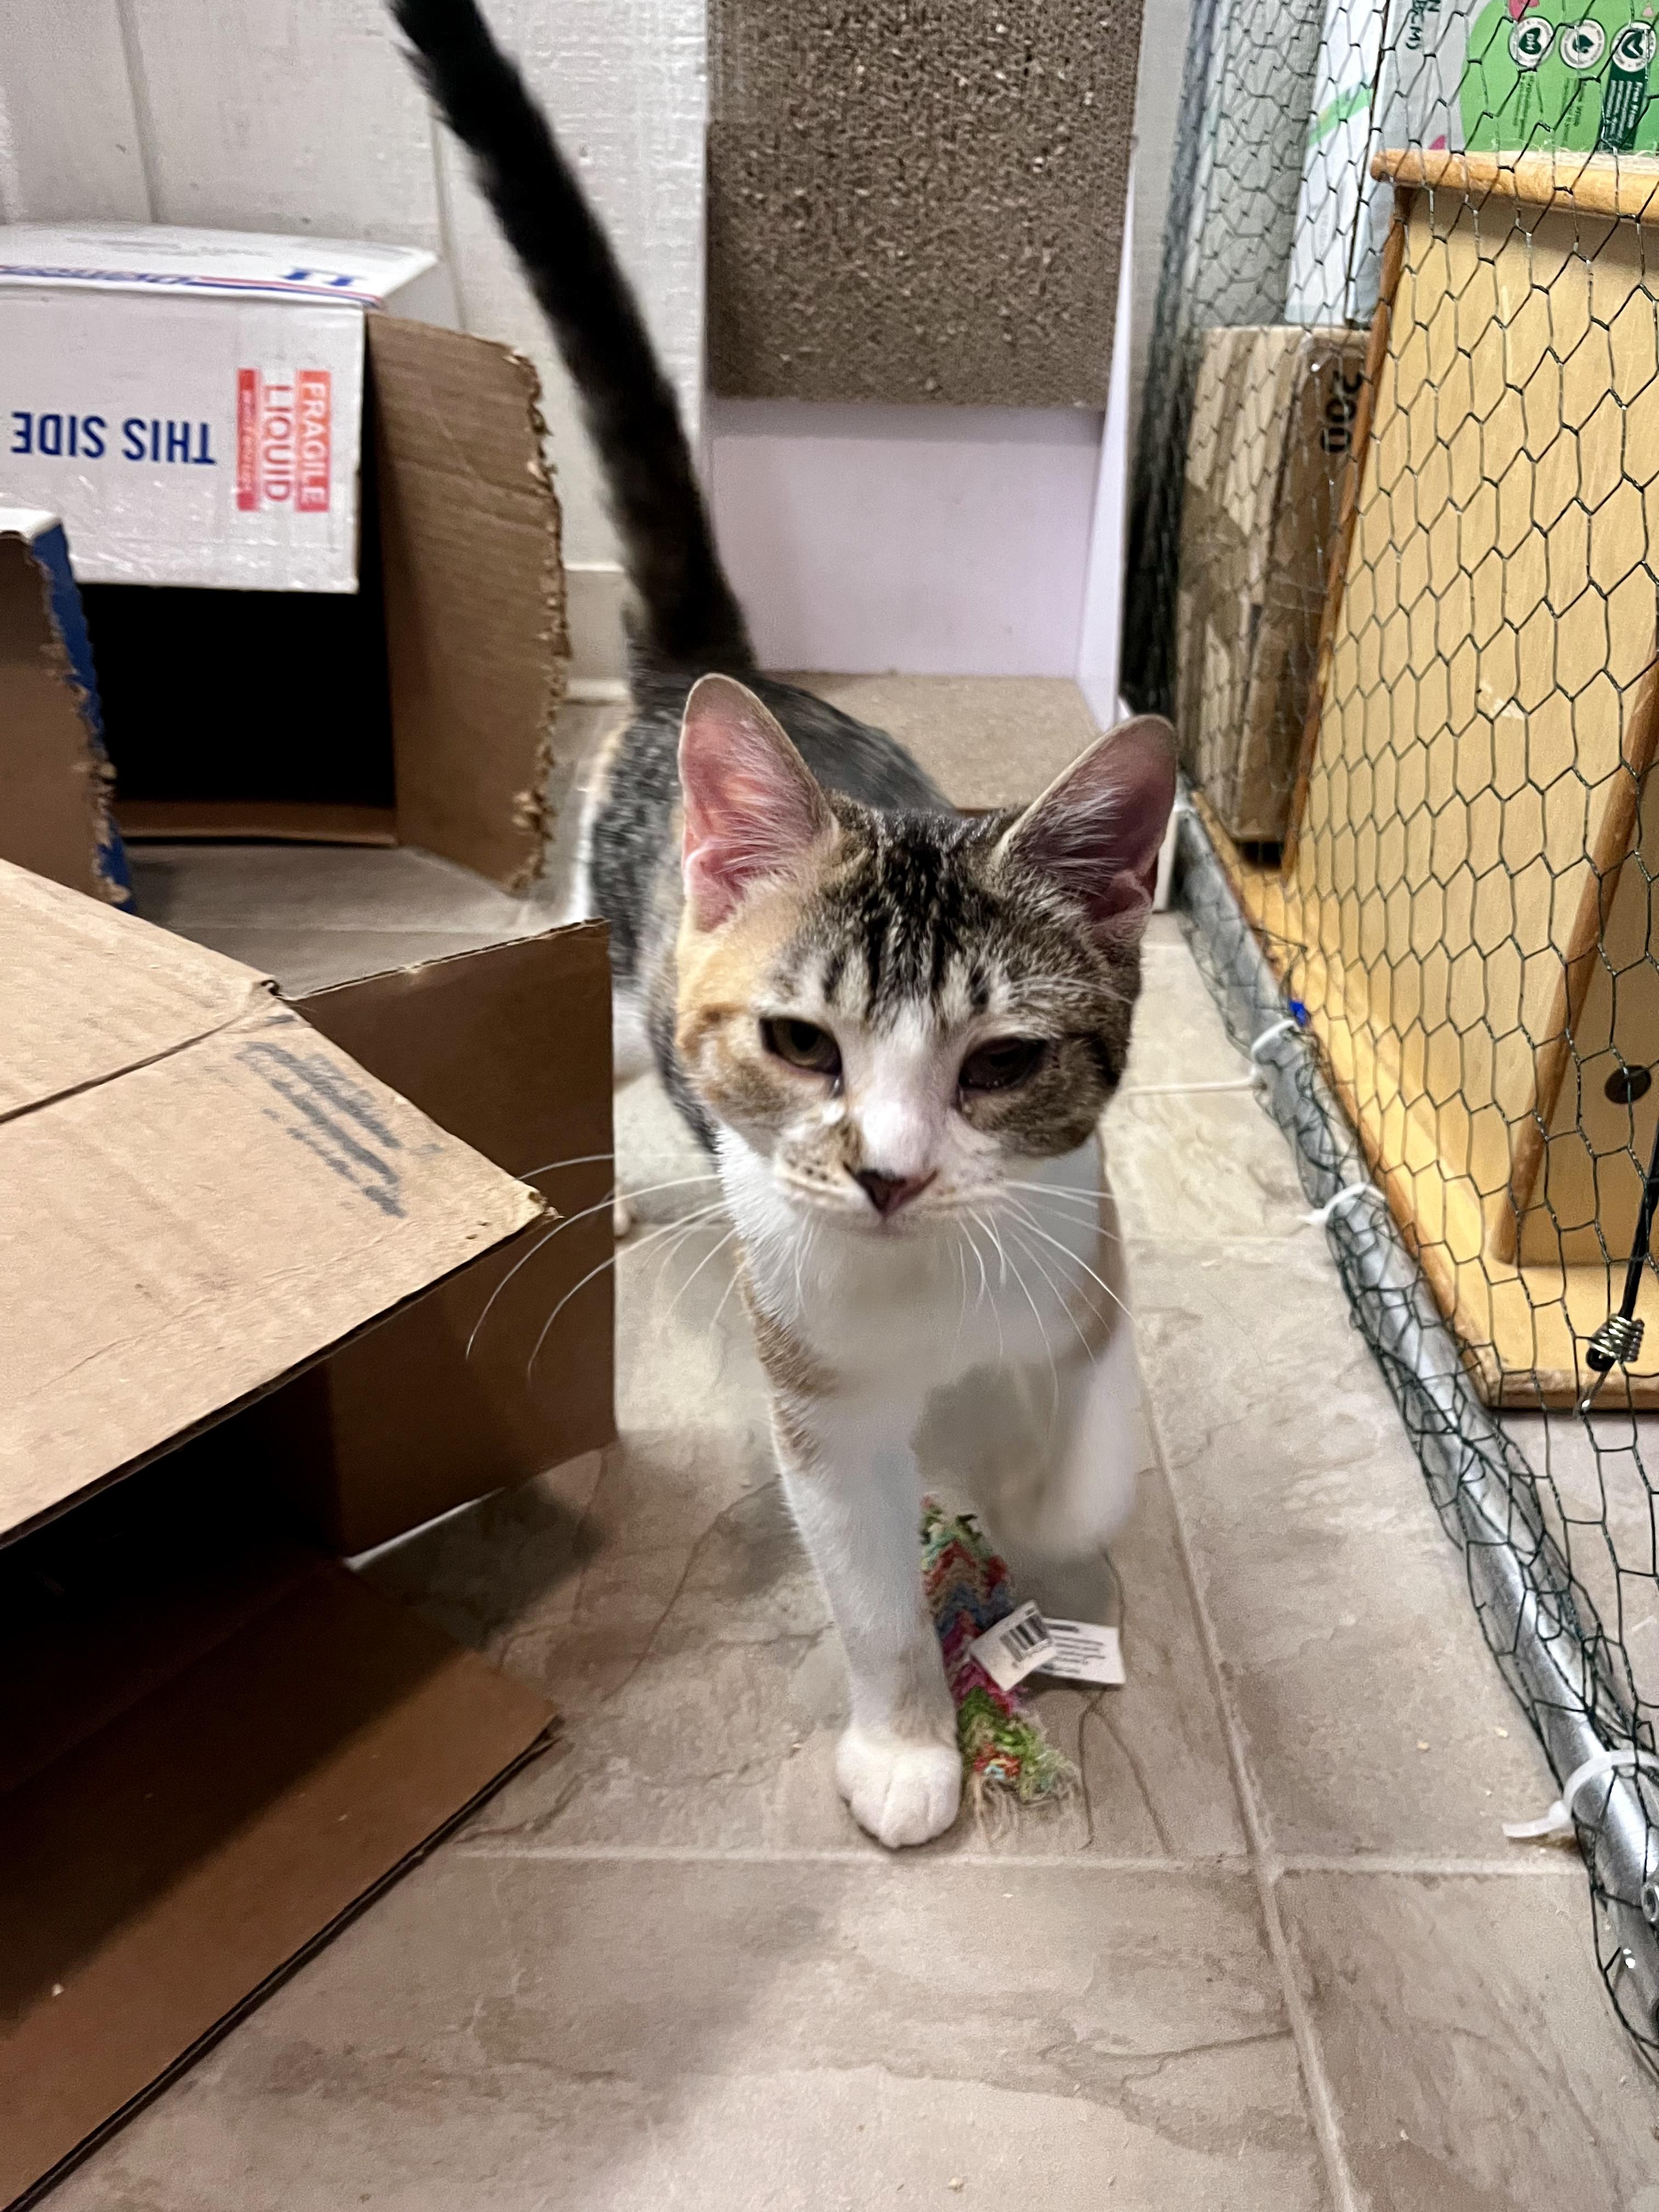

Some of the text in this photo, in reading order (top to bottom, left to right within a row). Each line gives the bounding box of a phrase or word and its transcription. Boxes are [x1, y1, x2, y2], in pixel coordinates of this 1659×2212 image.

[10, 411, 108, 459] SIDE
[121, 417, 217, 465] THIS
[263, 385, 292, 501] LIQUID
[301, 382, 327, 505] FRAGILE
